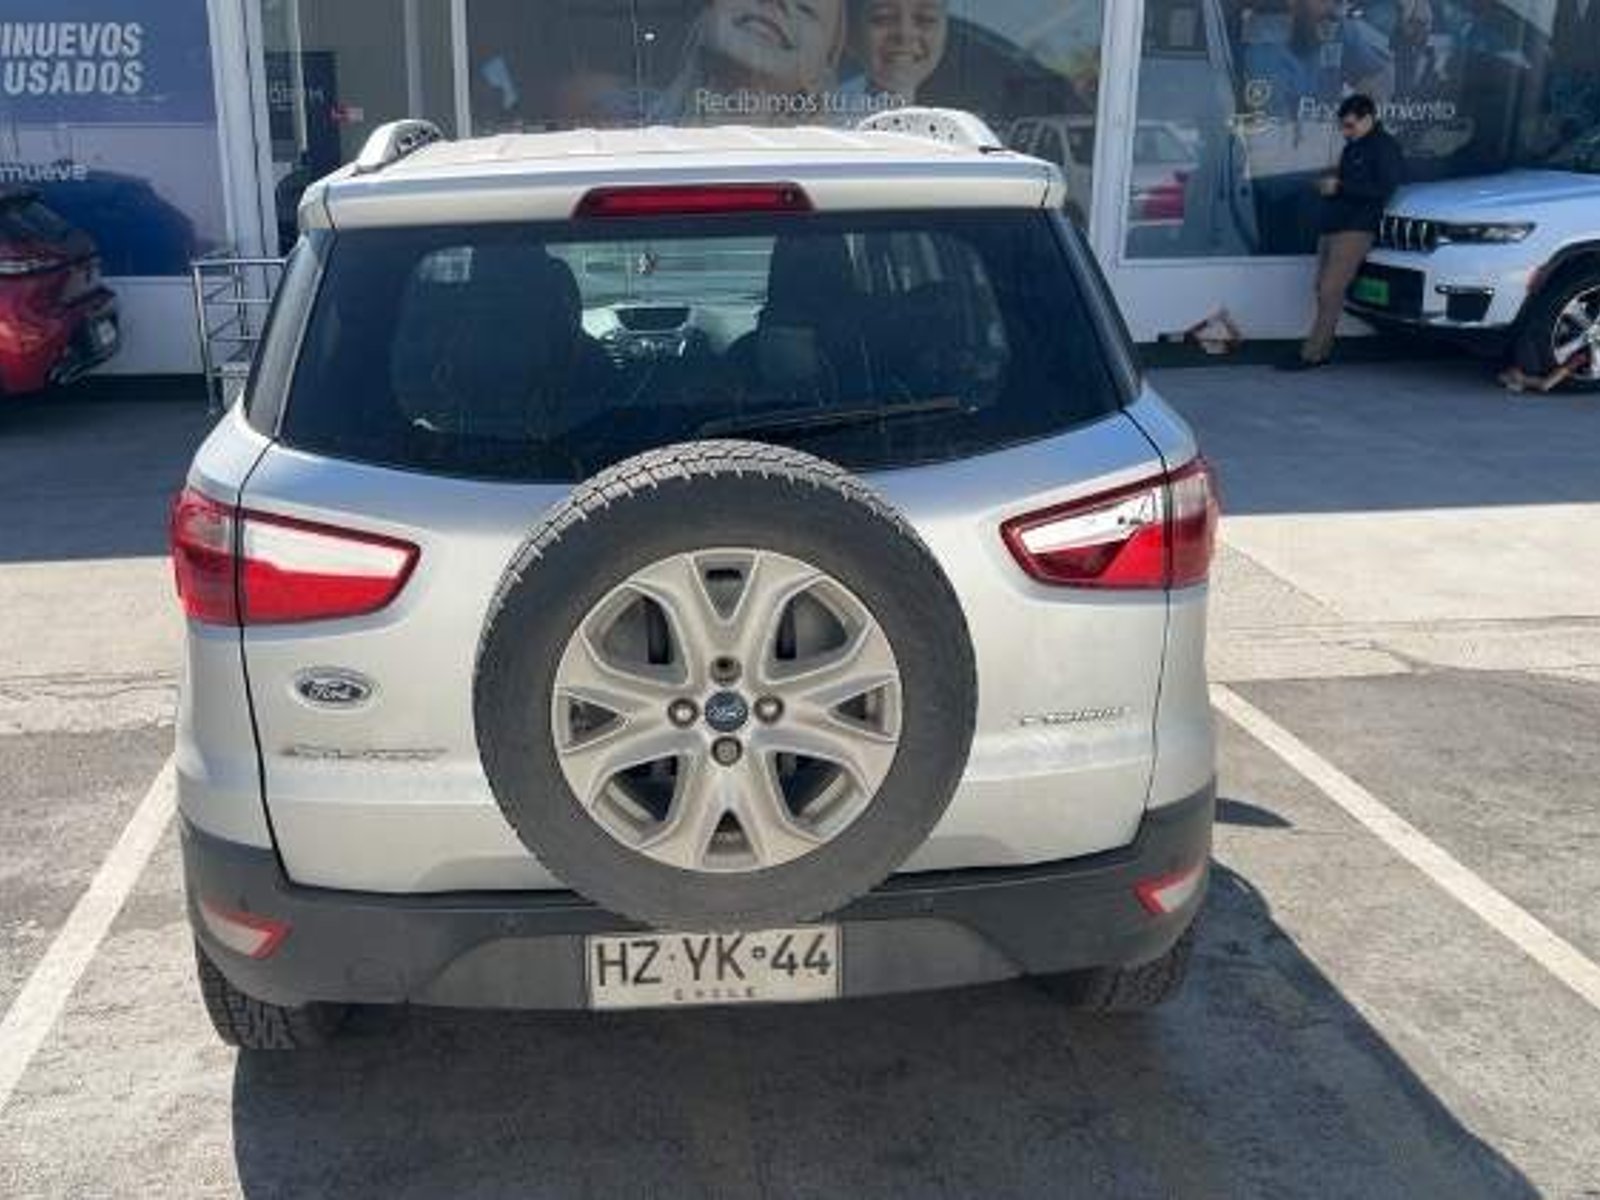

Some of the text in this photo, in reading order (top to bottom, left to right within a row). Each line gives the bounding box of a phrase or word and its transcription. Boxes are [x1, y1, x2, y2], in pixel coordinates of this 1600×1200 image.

[0, 22, 143, 57] INUEVOS
[4, 61, 142, 94] USADOS
[695, 87, 819, 114] Recibimos
